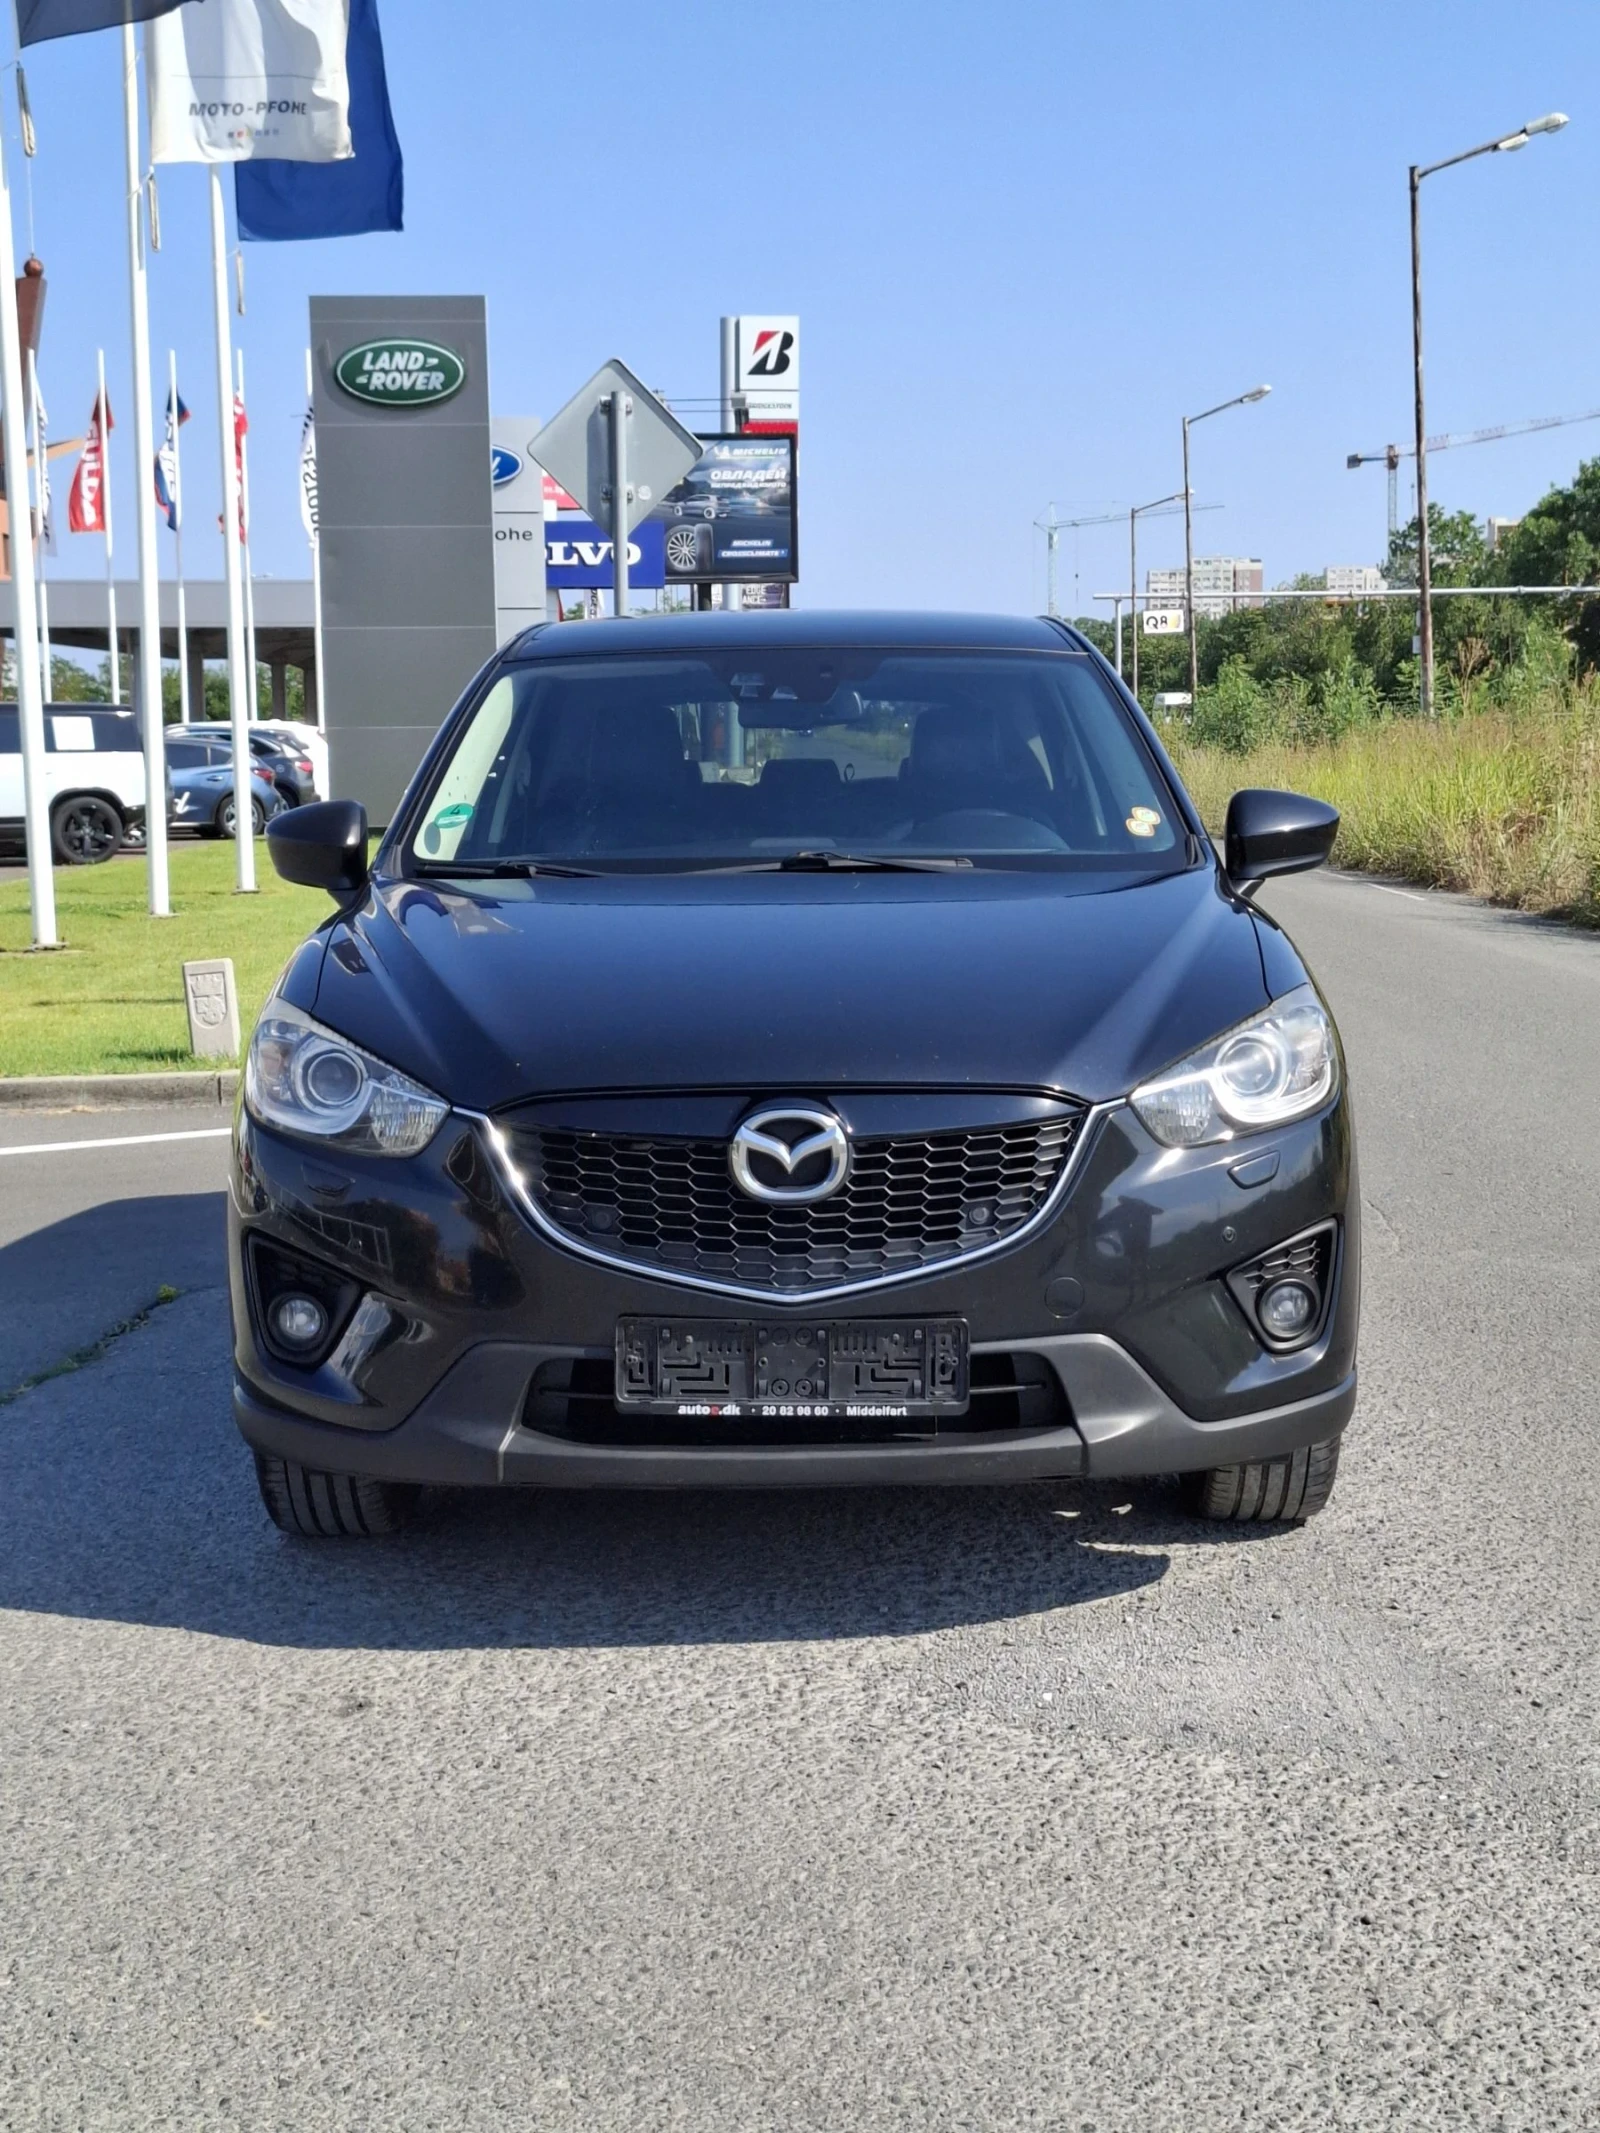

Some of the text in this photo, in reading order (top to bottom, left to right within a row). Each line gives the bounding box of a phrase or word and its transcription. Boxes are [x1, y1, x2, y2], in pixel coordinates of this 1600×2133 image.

[362, 351, 425, 371] LAND
[368, 371, 445, 391] ROVER
[733, 448, 787, 456] MICHELIN
[710, 467, 787, 481] ОВЛАДЕЙ
[1146, 616, 1168, 629] Q8
[762, 1406, 776, 1415] 20
[846, 1406, 907, 1416] Middelfart
